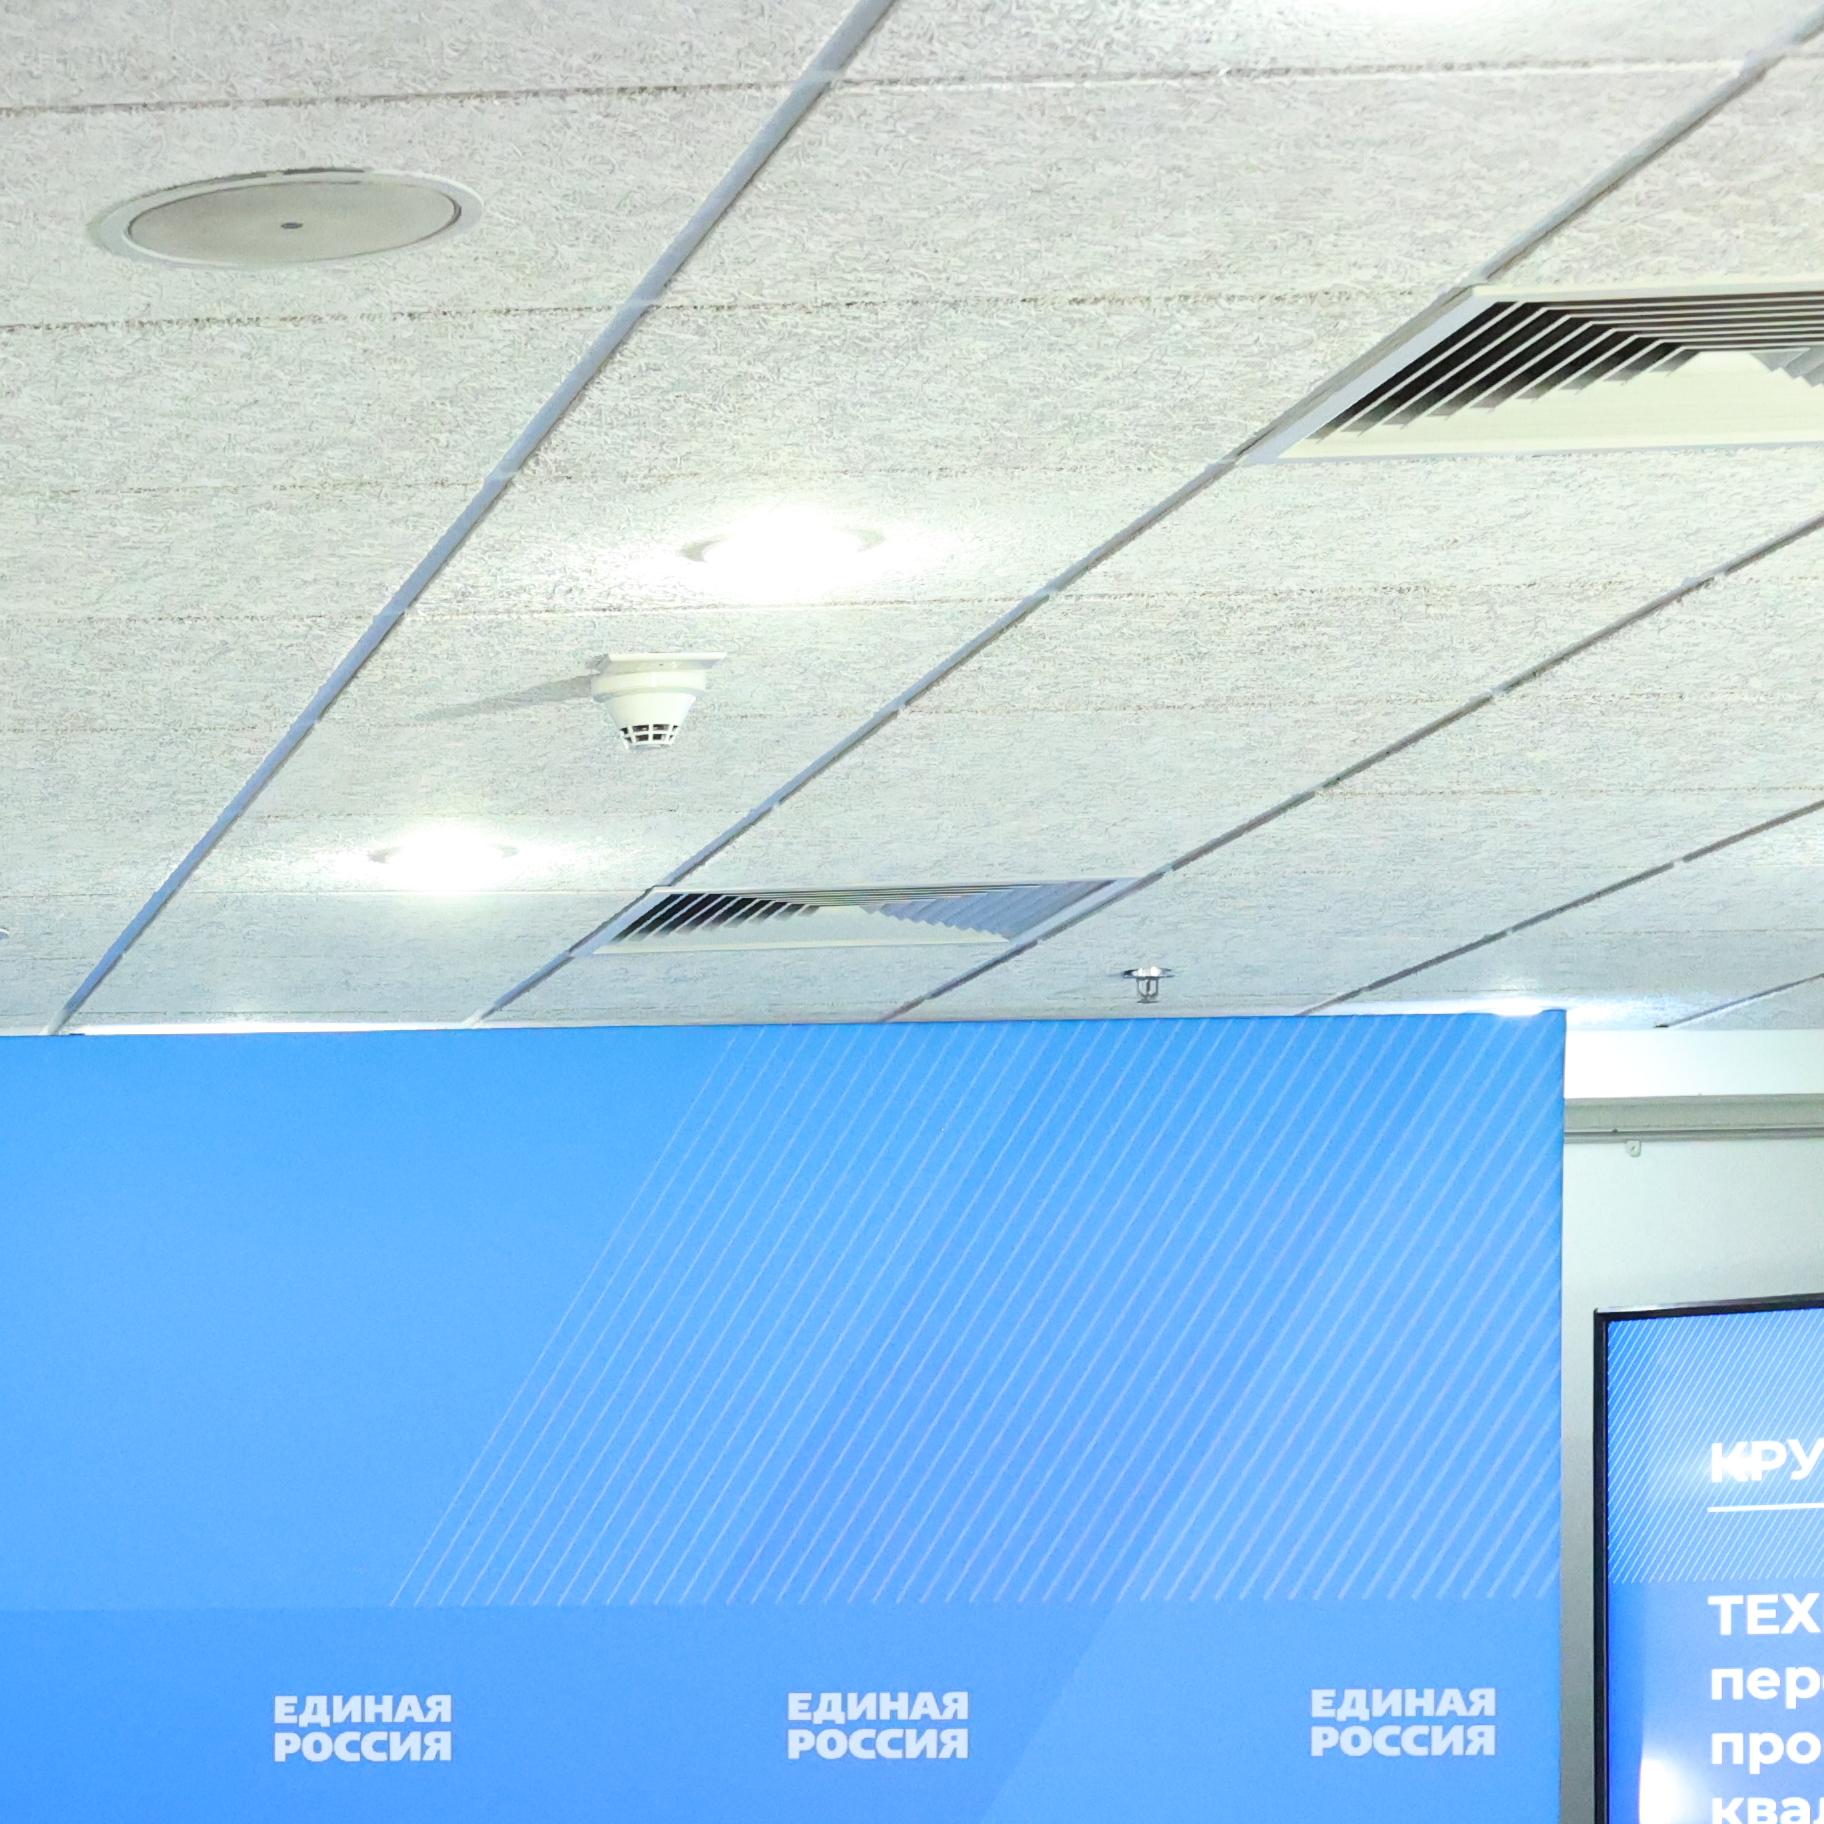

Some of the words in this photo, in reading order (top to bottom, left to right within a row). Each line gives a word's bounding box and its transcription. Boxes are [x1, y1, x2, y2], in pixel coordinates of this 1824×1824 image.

[1707, 1593, 1824, 1635] ТЕХ
[1711, 1667, 1824, 1709] пер
[274, 1695, 452, 1727] ЕДИНАЯ
[788, 1691, 968, 1724] ЕДИНАЯ
[1311, 1688, 1496, 1722] ЕДИНАЯ
[274, 1731, 451, 1762] РОССИЯ
[788, 1728, 968, 1759] РОССИЯ
[1311, 1725, 1496, 1756] РОССИЯ
[1711, 1732, 1821, 1774] про
